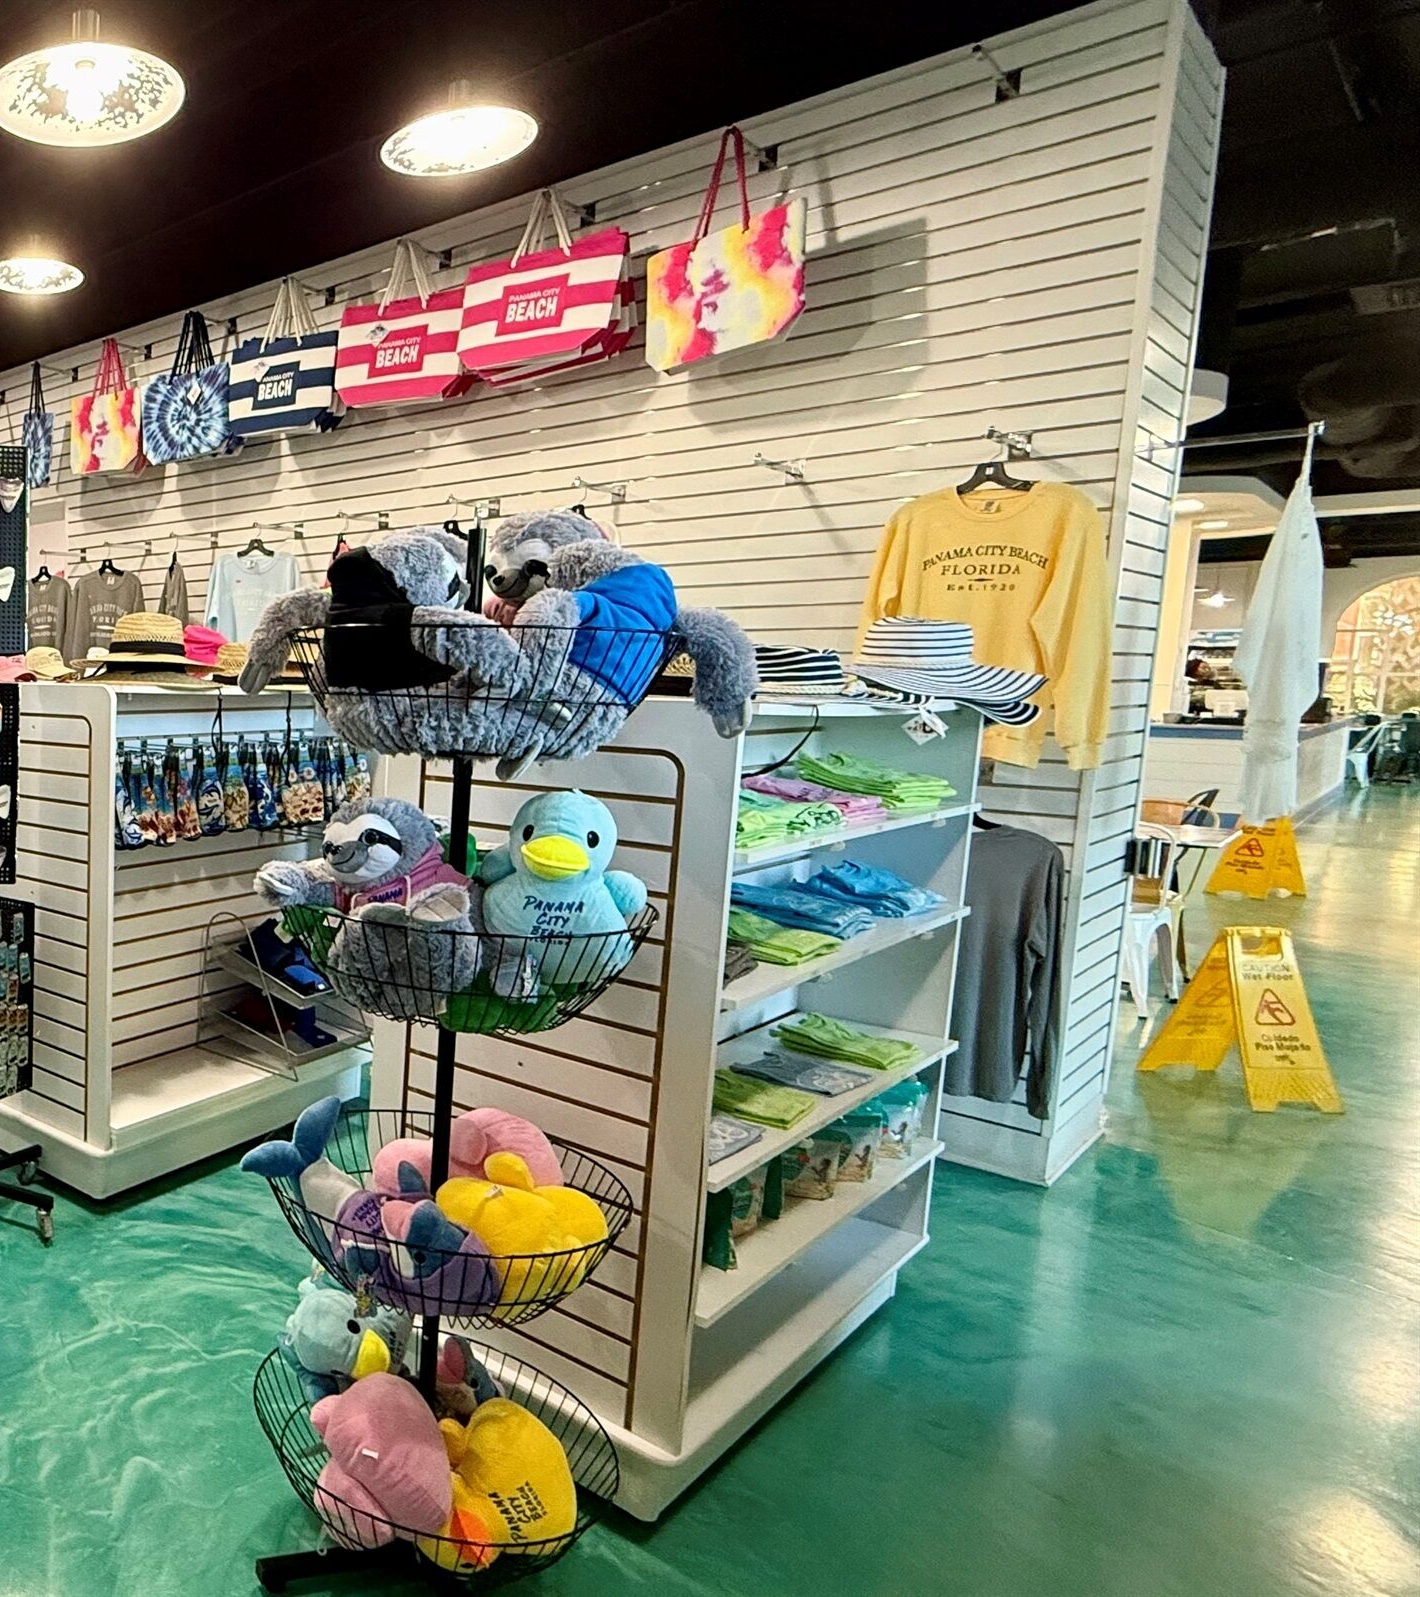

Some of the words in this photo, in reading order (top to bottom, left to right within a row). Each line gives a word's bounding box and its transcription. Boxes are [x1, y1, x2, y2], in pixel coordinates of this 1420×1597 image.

[508, 290, 541, 302] PANAMA
[542, 287, 560, 297] CITY
[505, 296, 559, 323] BEACH
[406, 336, 422, 345] CITY
[375, 345, 420, 368] BEACH
[257, 378, 293, 401] BEACH
[262, 374, 282, 383] ANAMA
[922, 545, 973, 571] PANAMA
[975, 545, 1008, 556] CITY
[1008, 546, 1049, 570] BEACH
[940, 563, 1020, 576] FLORIDA
[523, 895, 584, 914] PANAMA
[536, 911, 570, 929] CITY
[506, 1496, 532, 1524] CITY
[515, 1485, 543, 1522] BEACH
[487, 1491, 529, 1543] PANAMA
